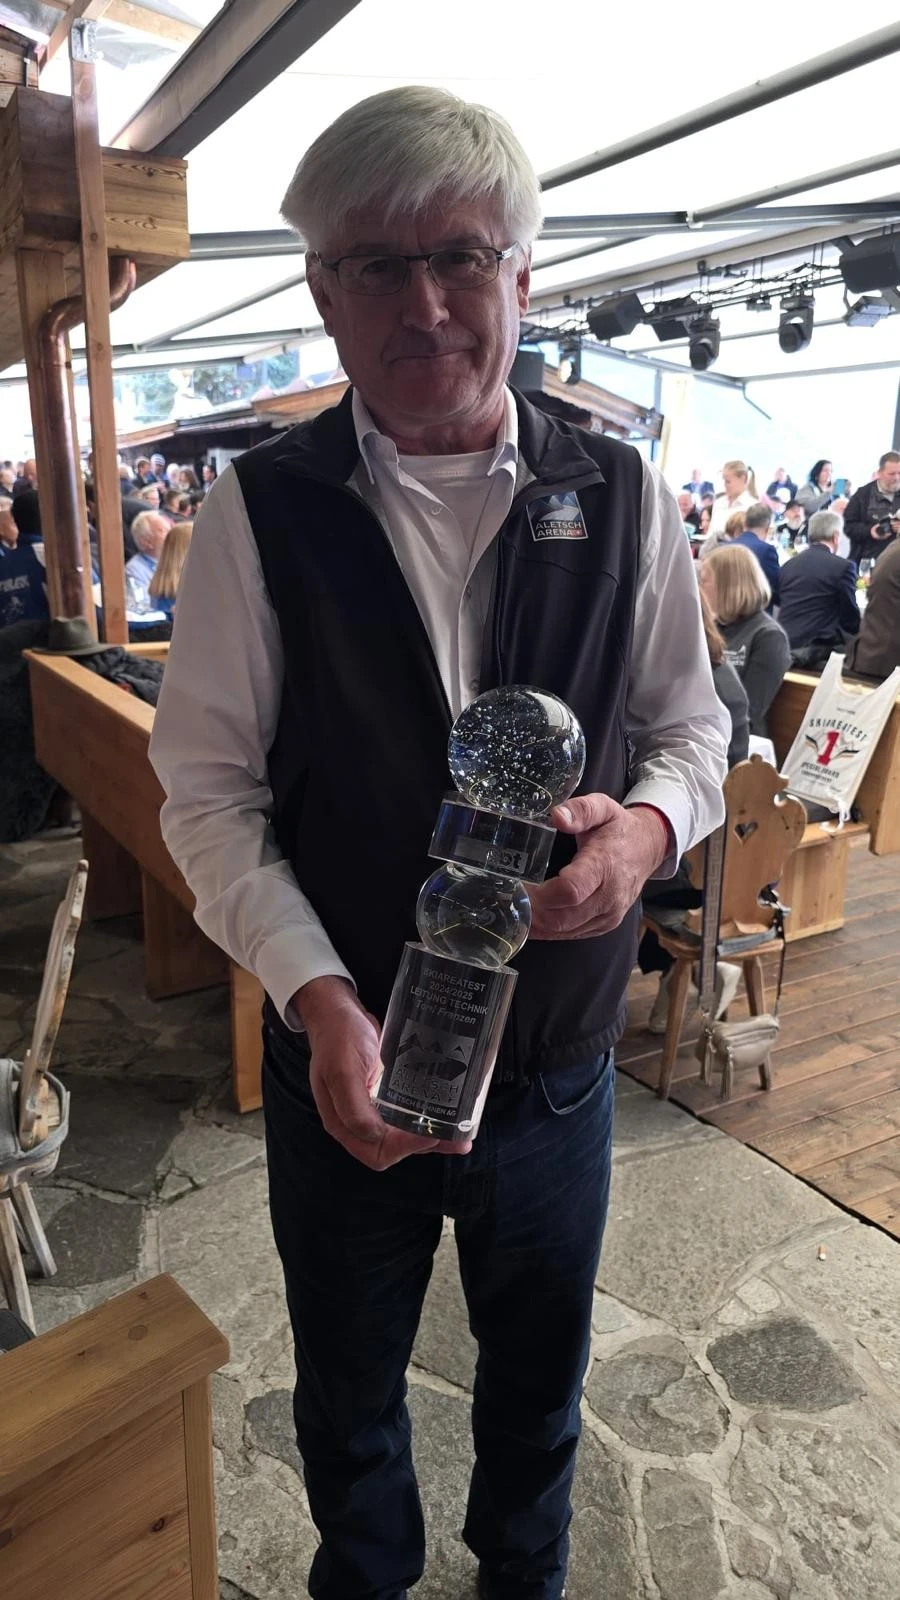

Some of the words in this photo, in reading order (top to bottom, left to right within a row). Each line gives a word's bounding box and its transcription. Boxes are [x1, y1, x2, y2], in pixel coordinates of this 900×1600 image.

[536, 521, 582, 530] ALETSCH
[537, 529, 574, 537] ARENA
[424, 968, 486, 992] SKIAREATEST
[410, 985, 446, 1004] LEITUNG
[450, 999, 488, 1015] TECHNIK
[430, 981, 473, 1000] 2024/2025
